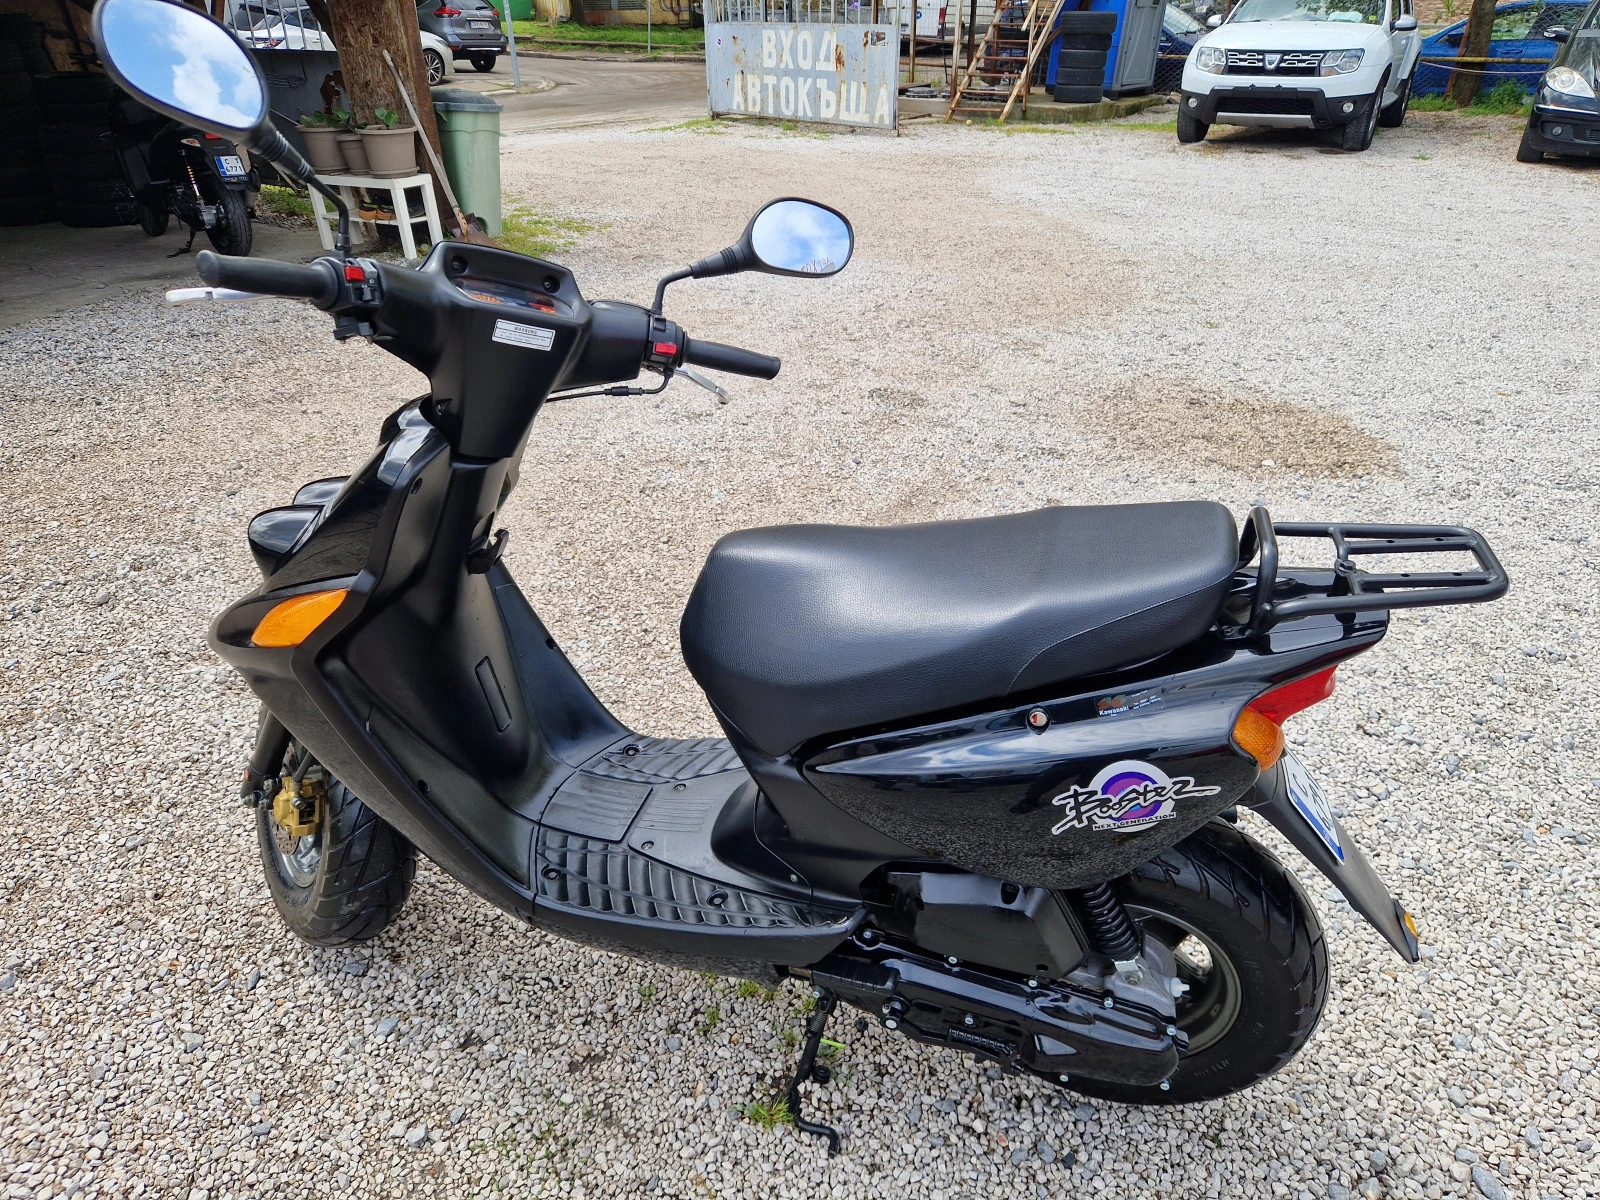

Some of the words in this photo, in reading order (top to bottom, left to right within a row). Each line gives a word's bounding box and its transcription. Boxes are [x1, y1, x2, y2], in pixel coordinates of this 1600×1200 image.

[762, 29, 837, 71] ВХОД
[732, 73, 890, 124] АВТОКЪЩА
[1099, 705, 1130, 716] Kawasaki
[1093, 822, 1118, 830] NEXT
[1119, 813, 1176, 827] GENERATION
